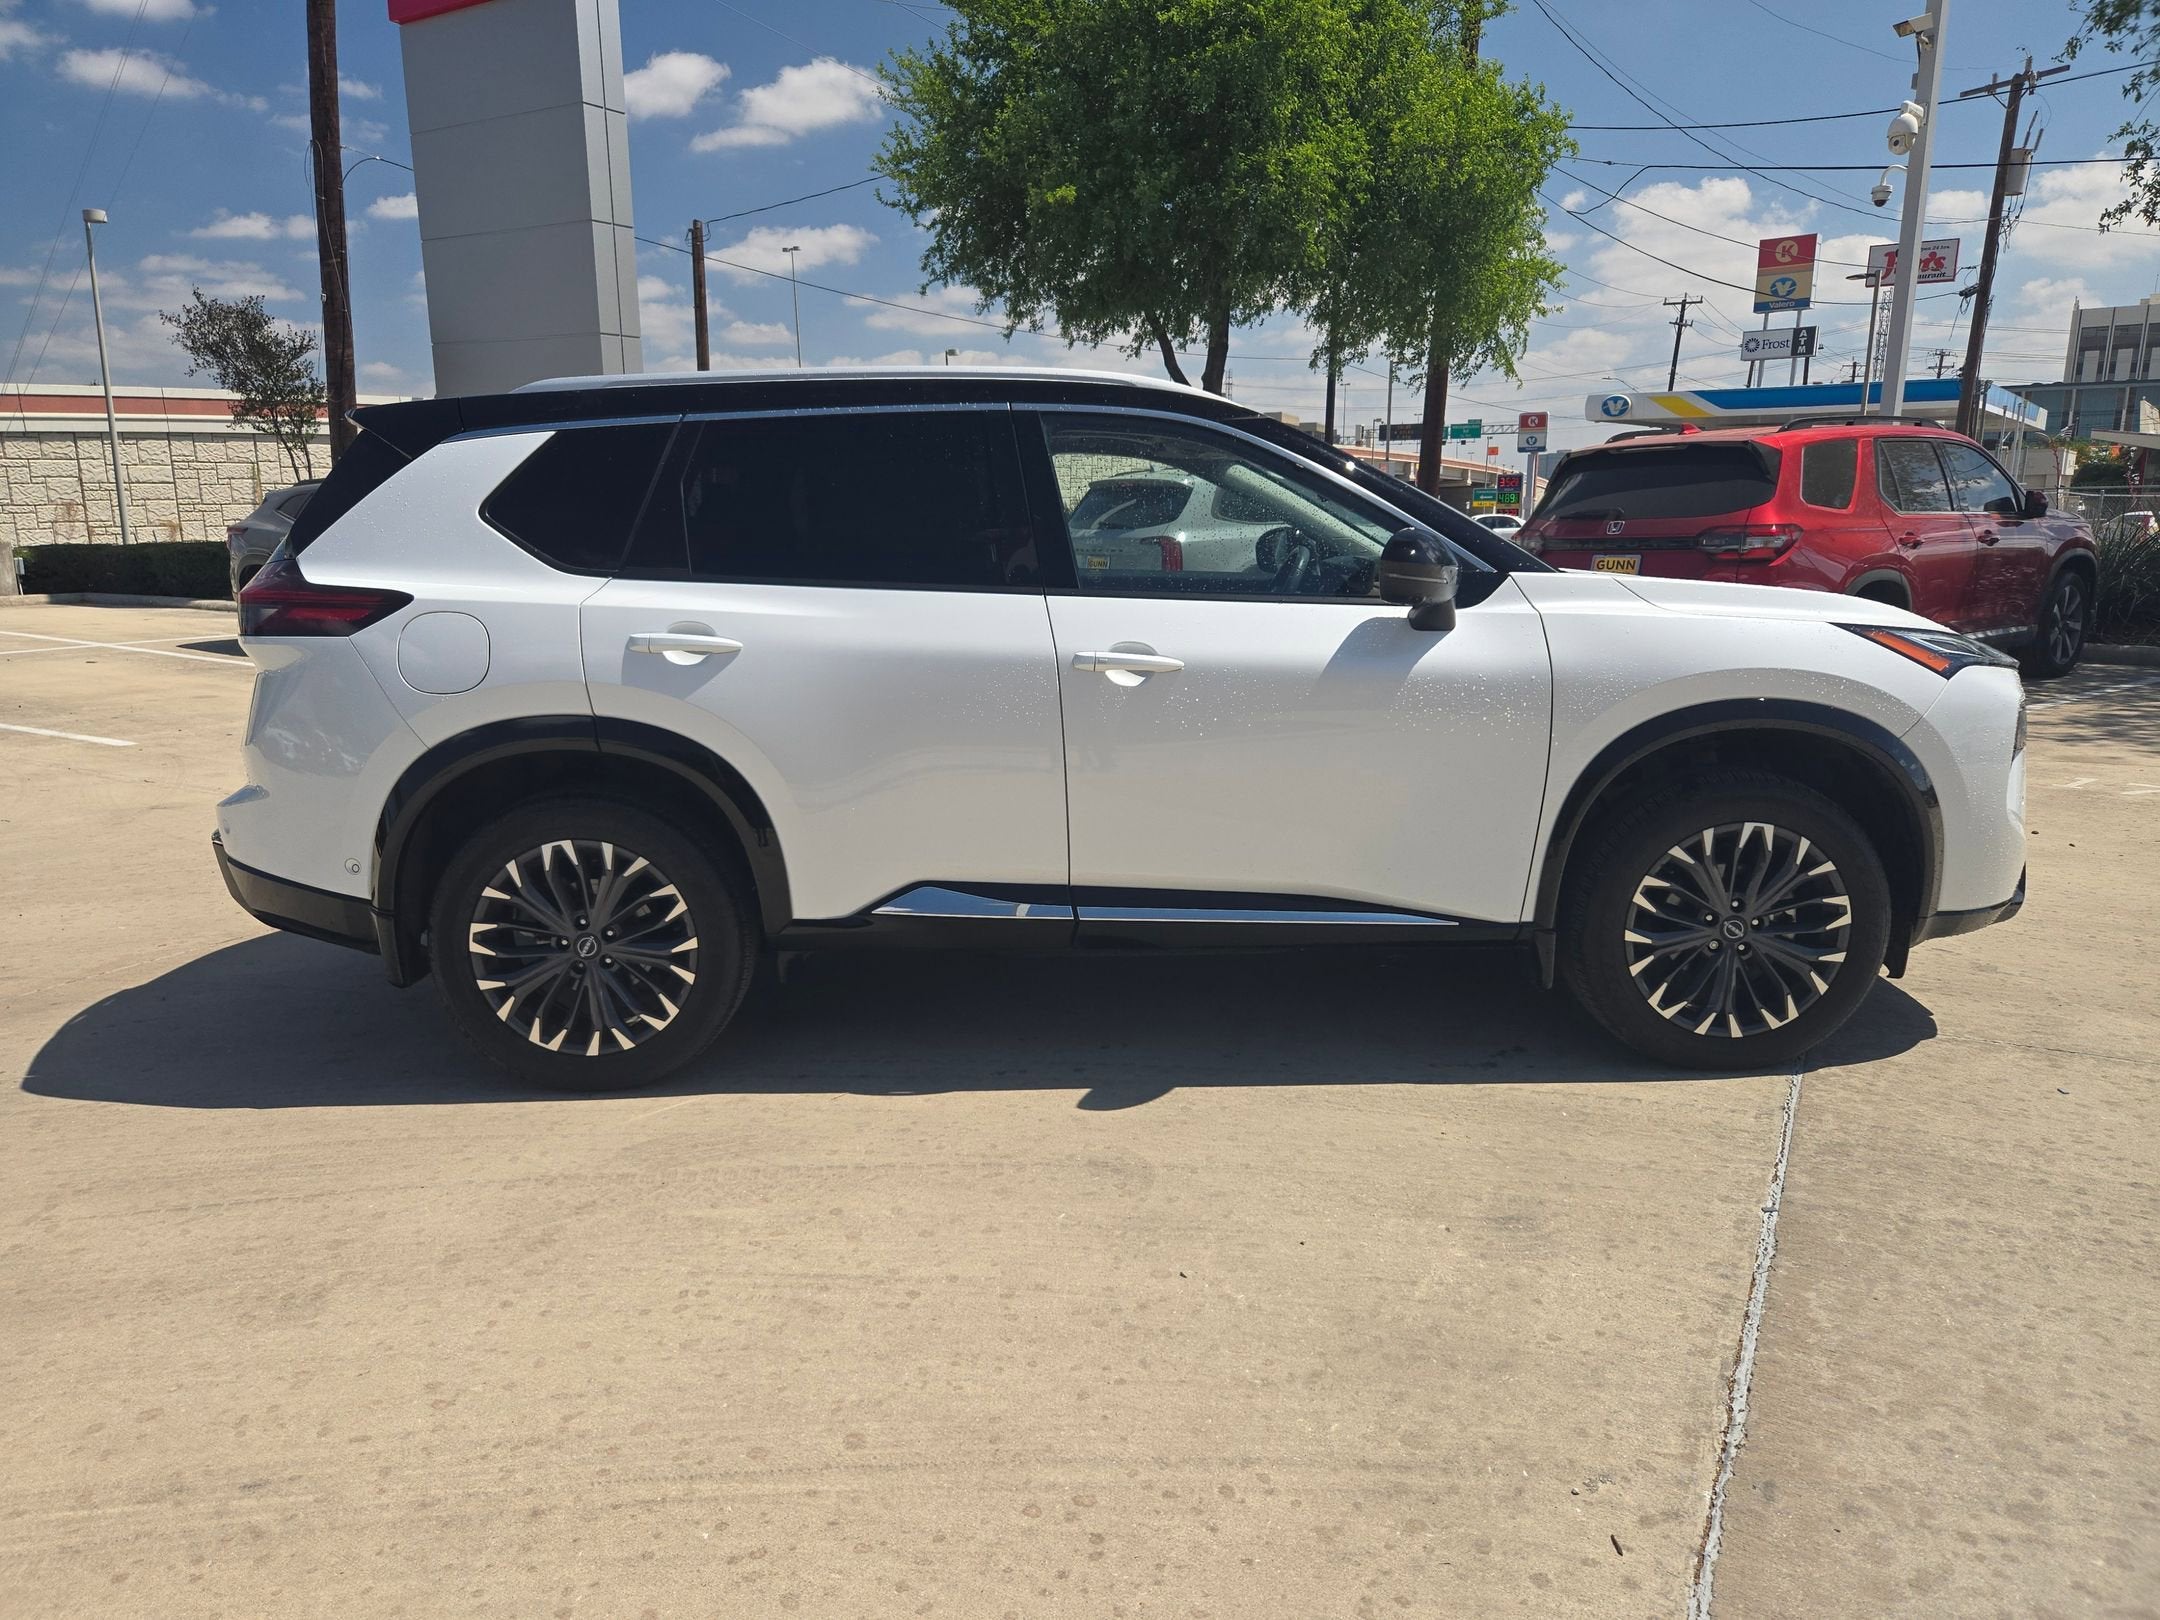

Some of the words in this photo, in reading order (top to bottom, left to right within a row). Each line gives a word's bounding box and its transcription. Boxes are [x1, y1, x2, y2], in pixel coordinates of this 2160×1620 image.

[1768, 301, 1796, 310] Valero
[1761, 337, 1792, 350] Frost
[1796, 329, 1808, 354] ATM
[1088, 559, 1109, 568] GUNN
[1596, 559, 1637, 570] GUNN
